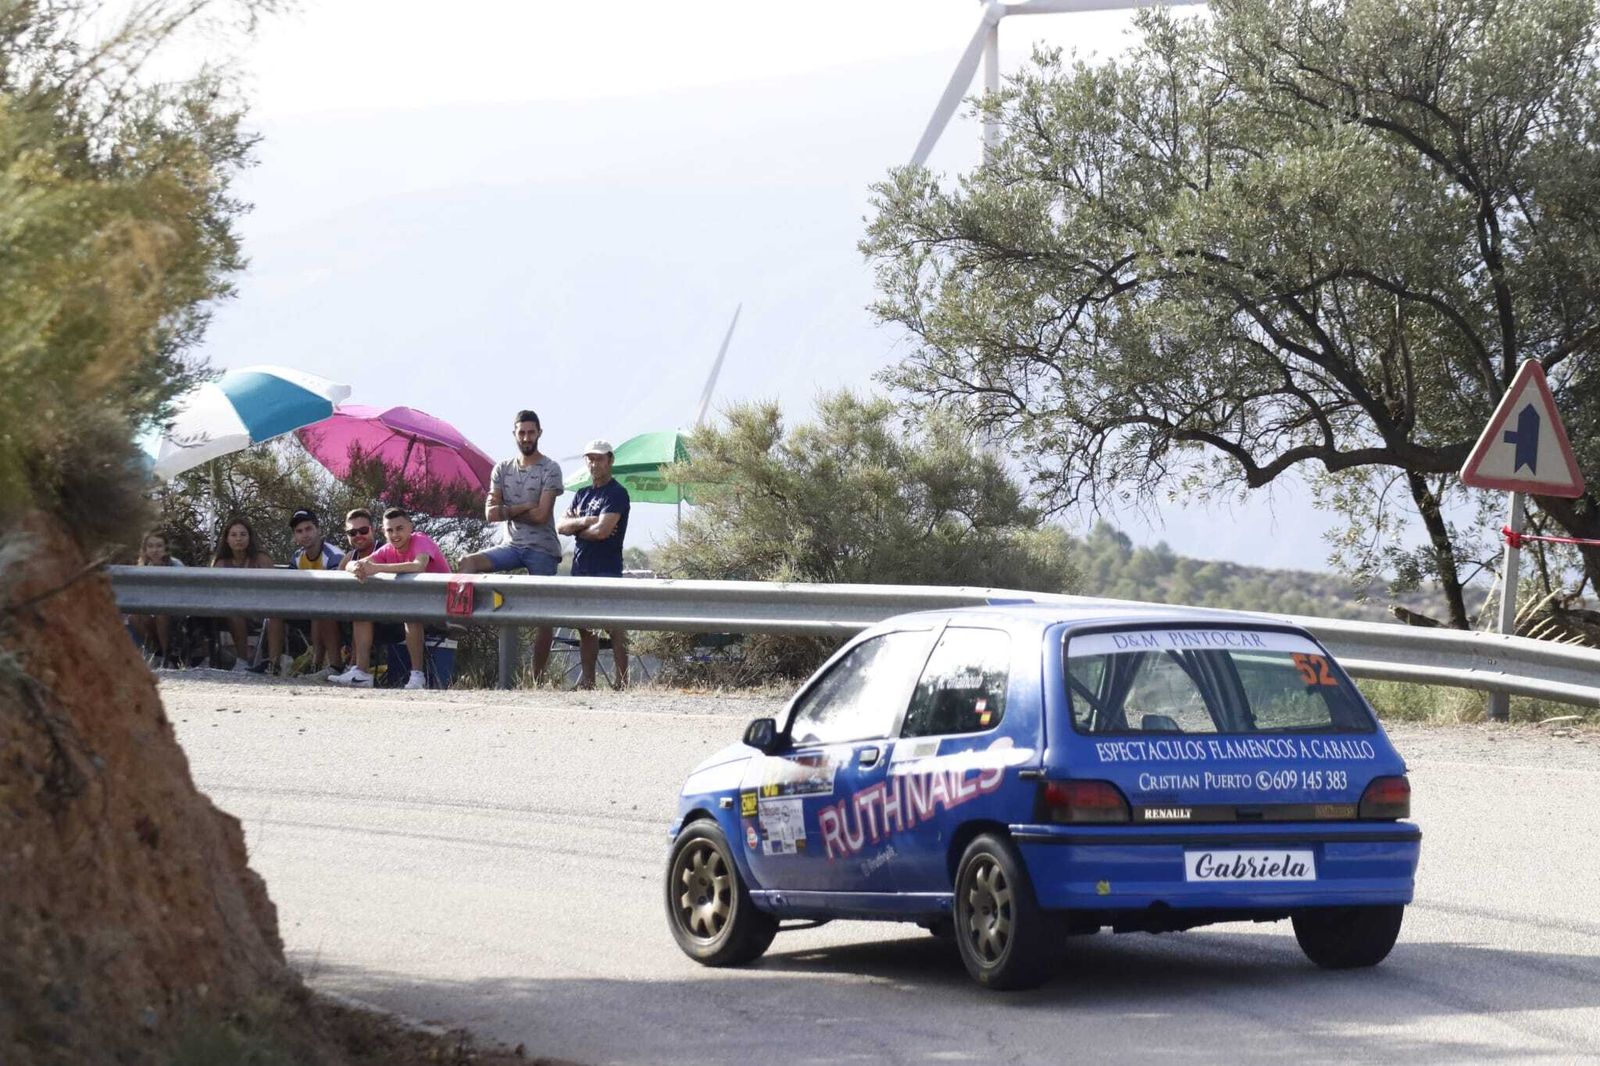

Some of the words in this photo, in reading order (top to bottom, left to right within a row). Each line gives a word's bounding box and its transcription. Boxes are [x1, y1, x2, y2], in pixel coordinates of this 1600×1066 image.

[1112, 633, 1160, 649] D&M
[1168, 630, 1266, 648] PINTOCAR
[1289, 653, 1339, 686] 52
[1096, 741, 1206, 762] ESPECTACULOS
[1209, 740, 1297, 760] FLAMENCOS
[1300, 741, 1311, 759] A
[1312, 739, 1375, 759] CABALLO
[1273, 771, 1298, 790] 609
[1302, 772, 1323, 790] 145
[1325, 771, 1348, 790] 383
[1144, 808, 1192, 819] RENAULT
[1195, 852, 1309, 879] Gabriela
